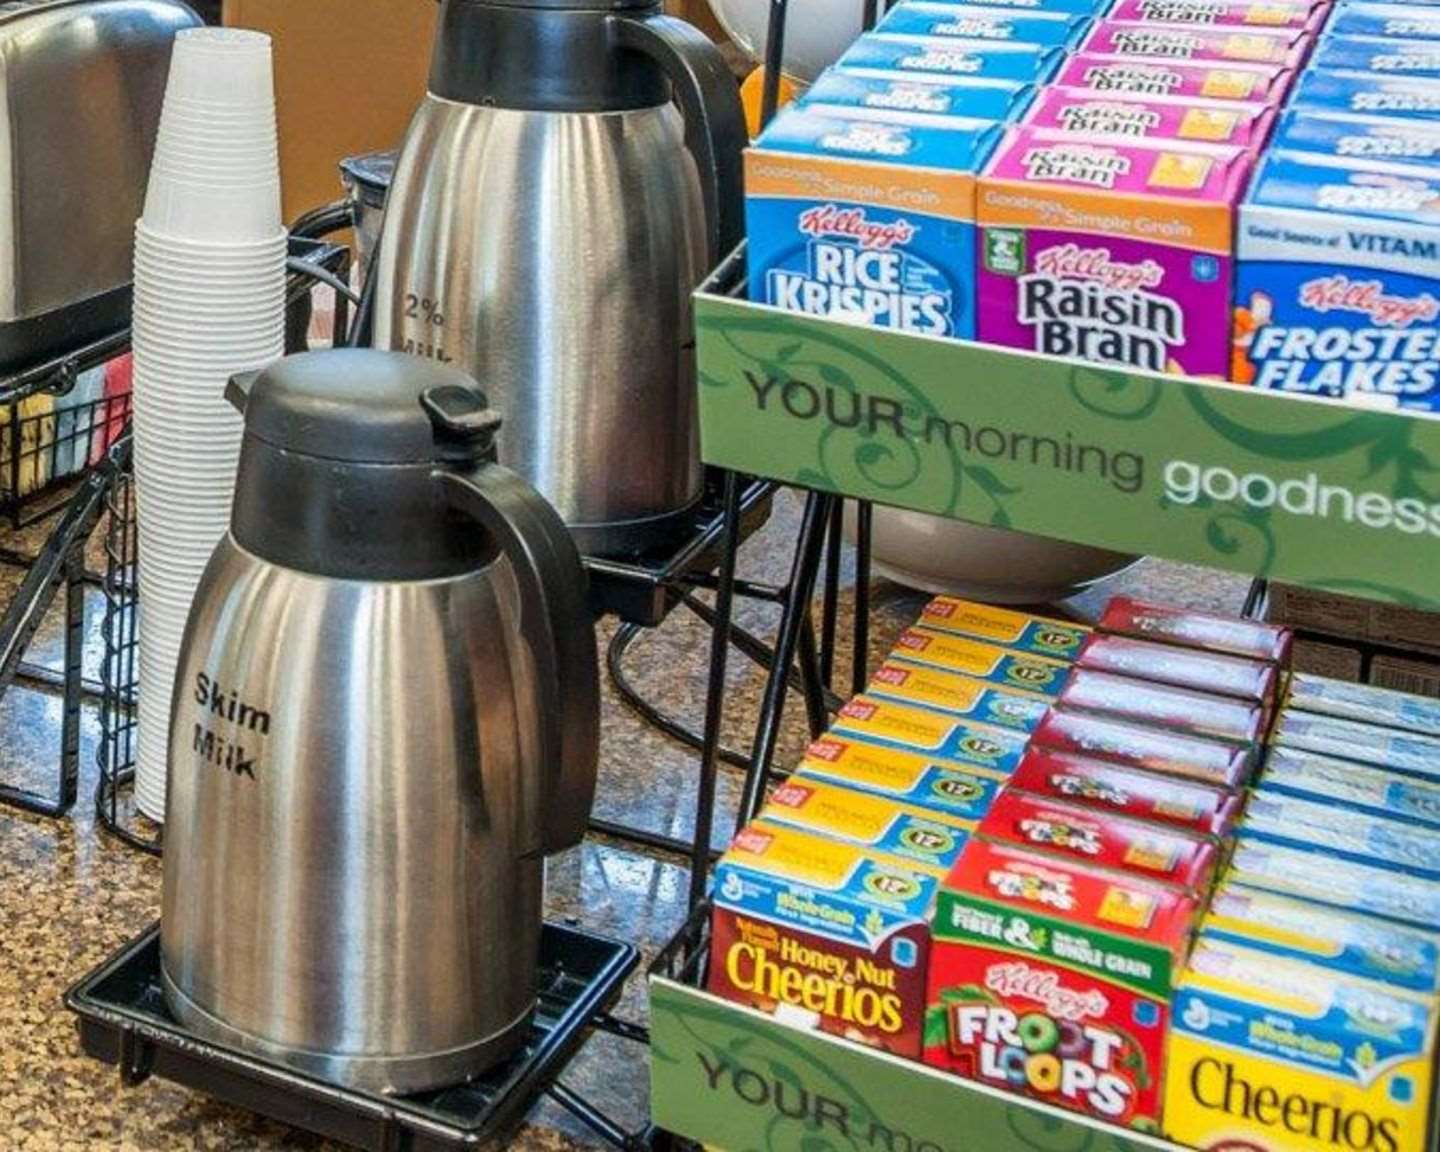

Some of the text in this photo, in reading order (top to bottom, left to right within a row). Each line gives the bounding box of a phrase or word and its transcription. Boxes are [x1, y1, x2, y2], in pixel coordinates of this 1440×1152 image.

[1068, 118, 1140, 136] Bran
[1034, 163, 1109, 184] Bran
[802, 205, 911, 249] Kellogg's
[816, 244, 900, 292] RICE
[1036, 244, 1163, 288] Kellogg's
[405, 294, 445, 326] 2%
[774, 274, 948, 337] KRISPIES
[1025, 278, 1177, 340] Raisin
[1301, 276, 1438, 326] Kellogg's
[1042, 320, 1163, 374] Bran
[1252, 327, 1440, 361] FROSTE
[1258, 360, 1434, 396] FLAKES
[742, 369, 905, 439] YOUR
[924, 414, 1145, 494] morning
[195, 672, 270, 735] Skim
[194, 723, 256, 781] Milk
[726, 942, 903, 1032] Cheerios
[781, 937, 896, 990] Honey Nut
[958, 1005, 1122, 1070] FROOT
[697, 1052, 850, 1139] YOUR
[980, 1042, 1131, 1116] LOOPS
[1190, 1057, 1400, 1152] Cheerios
